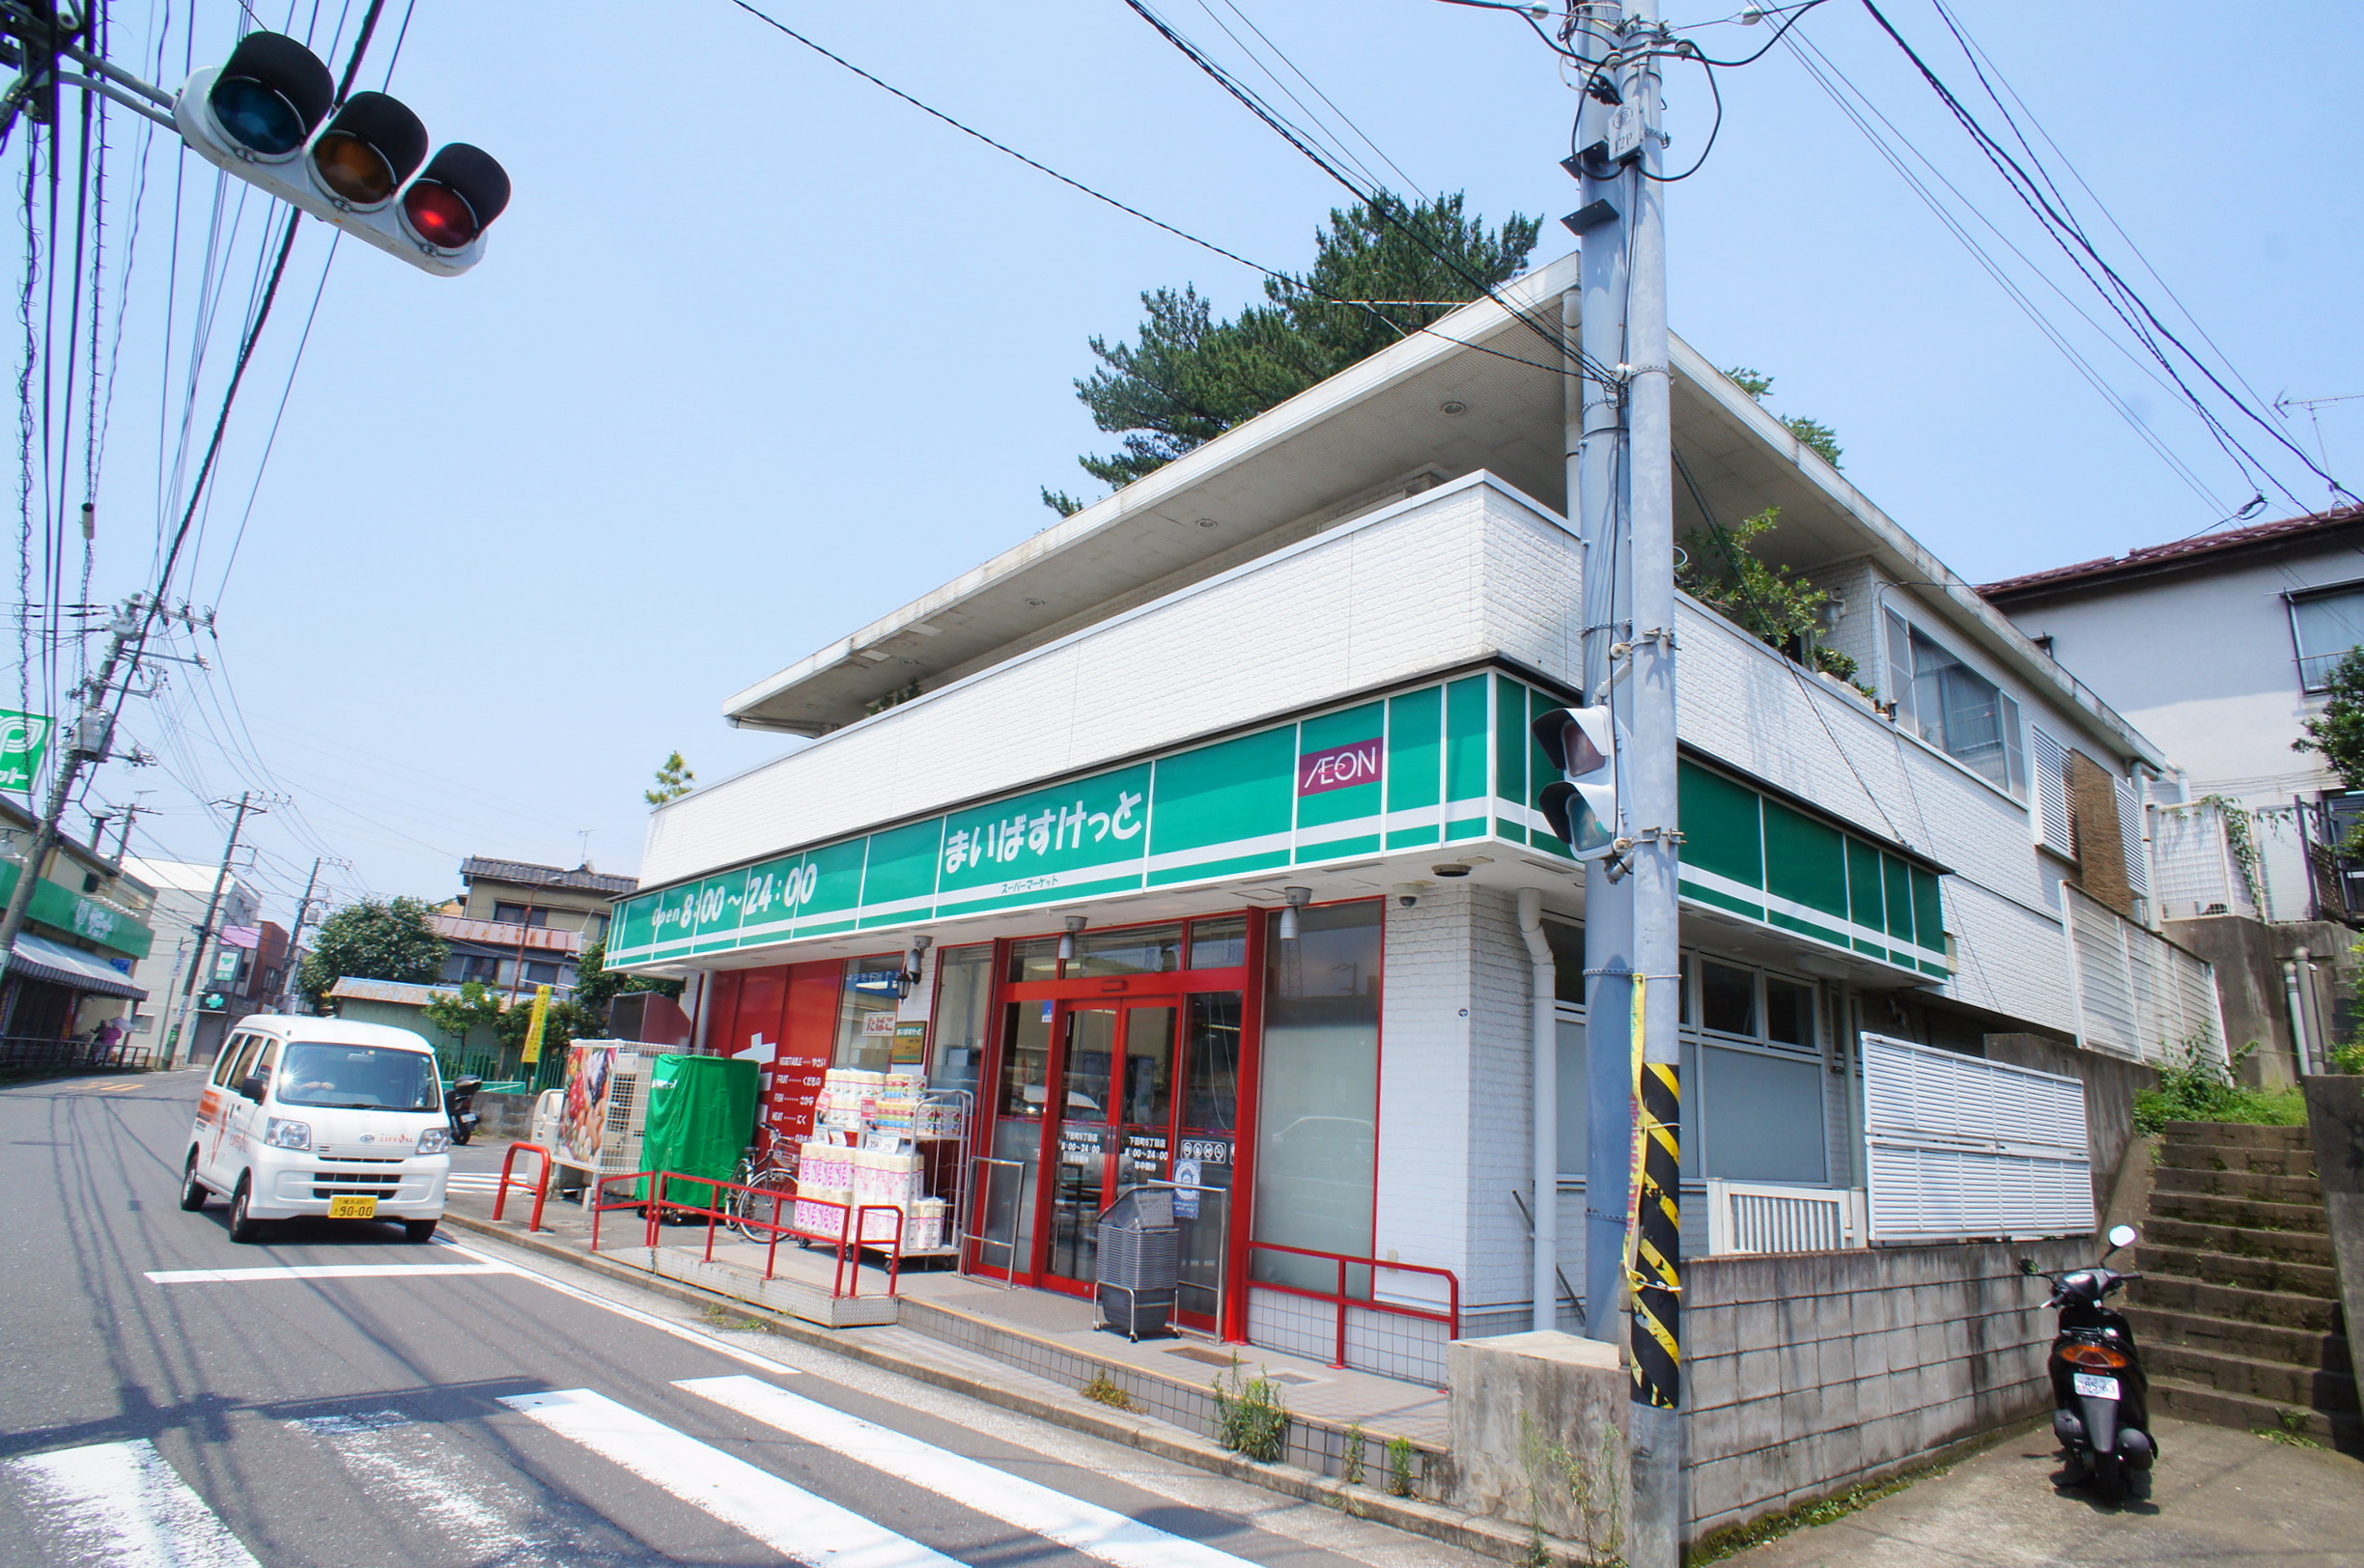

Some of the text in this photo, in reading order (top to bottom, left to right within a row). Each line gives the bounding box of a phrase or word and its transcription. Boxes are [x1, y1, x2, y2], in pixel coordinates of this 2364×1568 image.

[945, 791, 1142, 874] まいばすけっと
[1001, 875, 1058, 895] スーパーマーケット
[652, 908, 680, 927] Open
[866, 1016, 894, 1032] たばこ
[340, 1206, 374, 1218] 90-00
